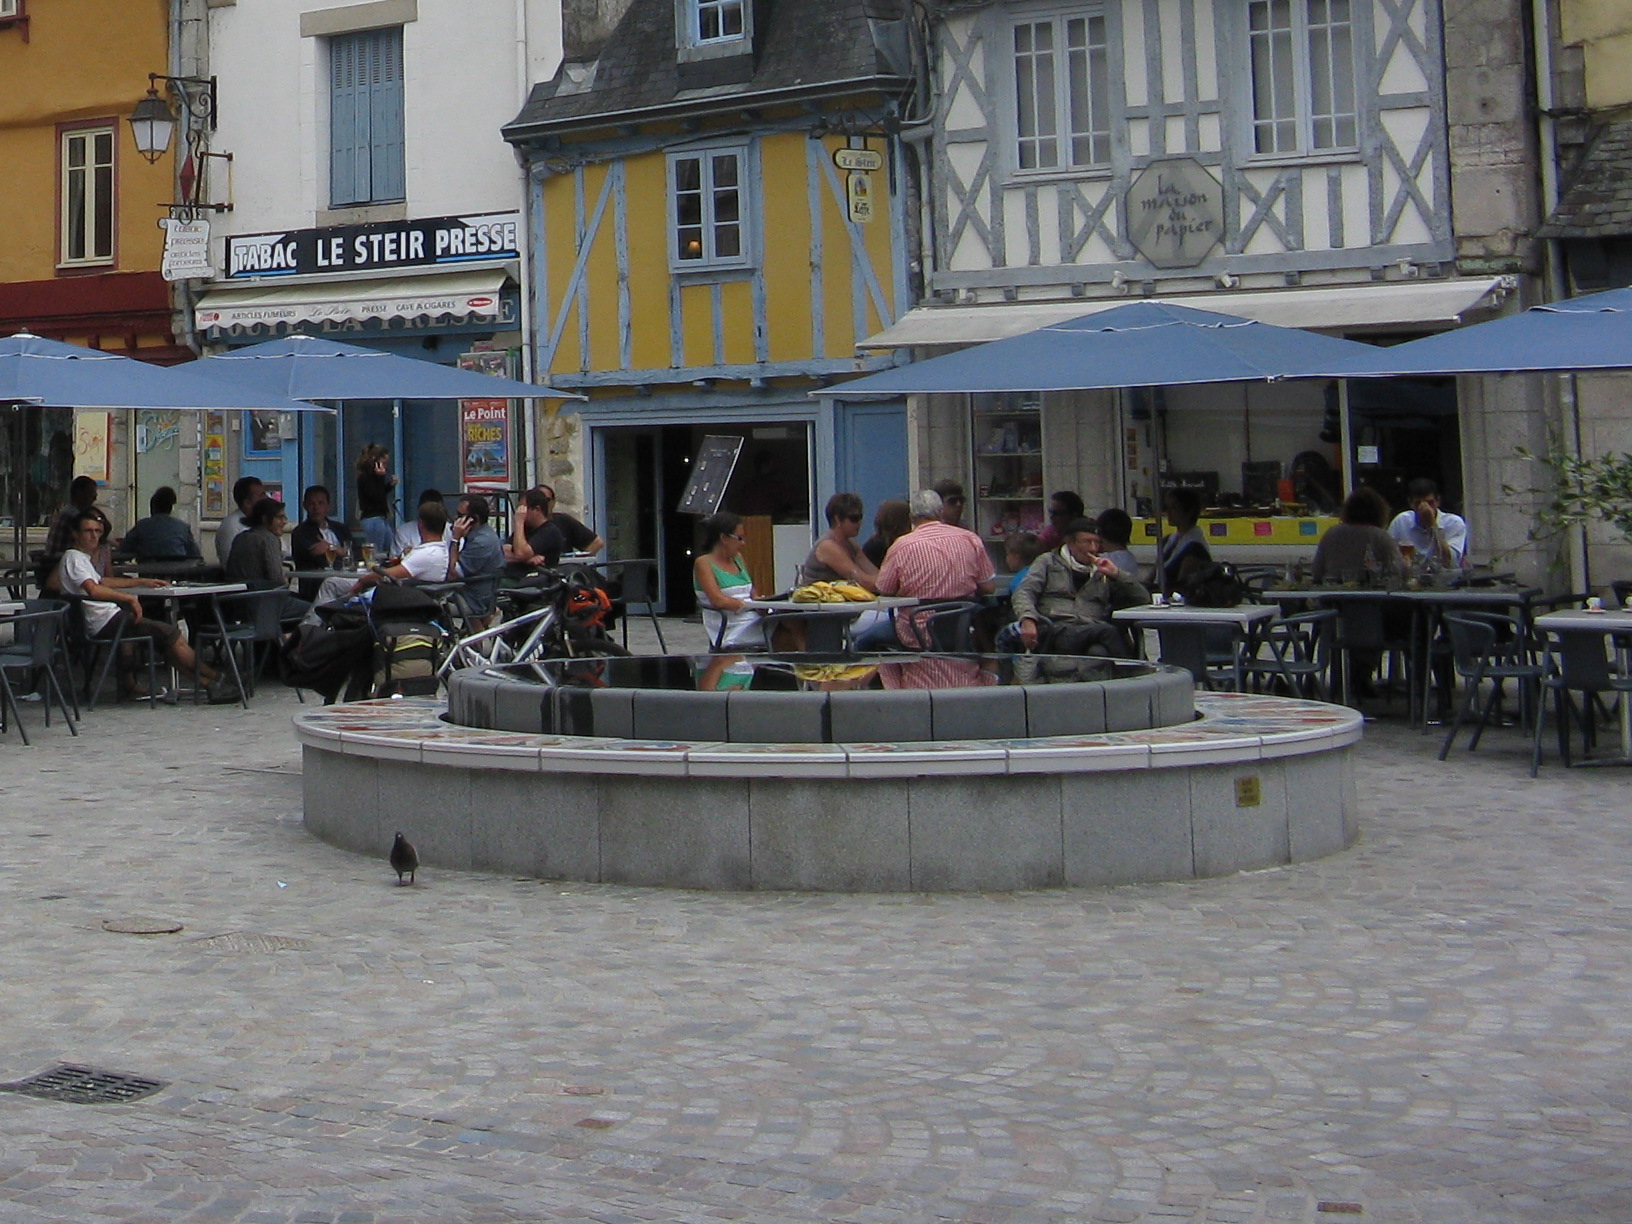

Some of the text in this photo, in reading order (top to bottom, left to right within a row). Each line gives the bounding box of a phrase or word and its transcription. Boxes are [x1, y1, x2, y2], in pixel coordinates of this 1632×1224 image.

[1141, 192, 1208, 211] maison
[1169, 207, 1188, 222] du
[1155, 218, 1213, 247] papier
[234, 222, 517, 271] TABAC LE STEIR PRESSE
[231, 311, 262, 320] ARTICLES
[361, 304, 387, 313] PRESSE
[396, 303, 415, 312] CAVE
[424, 300, 456, 310] CIGARES
[464, 406, 506, 420] Le Point
[468, 426, 503, 443] RICHES
